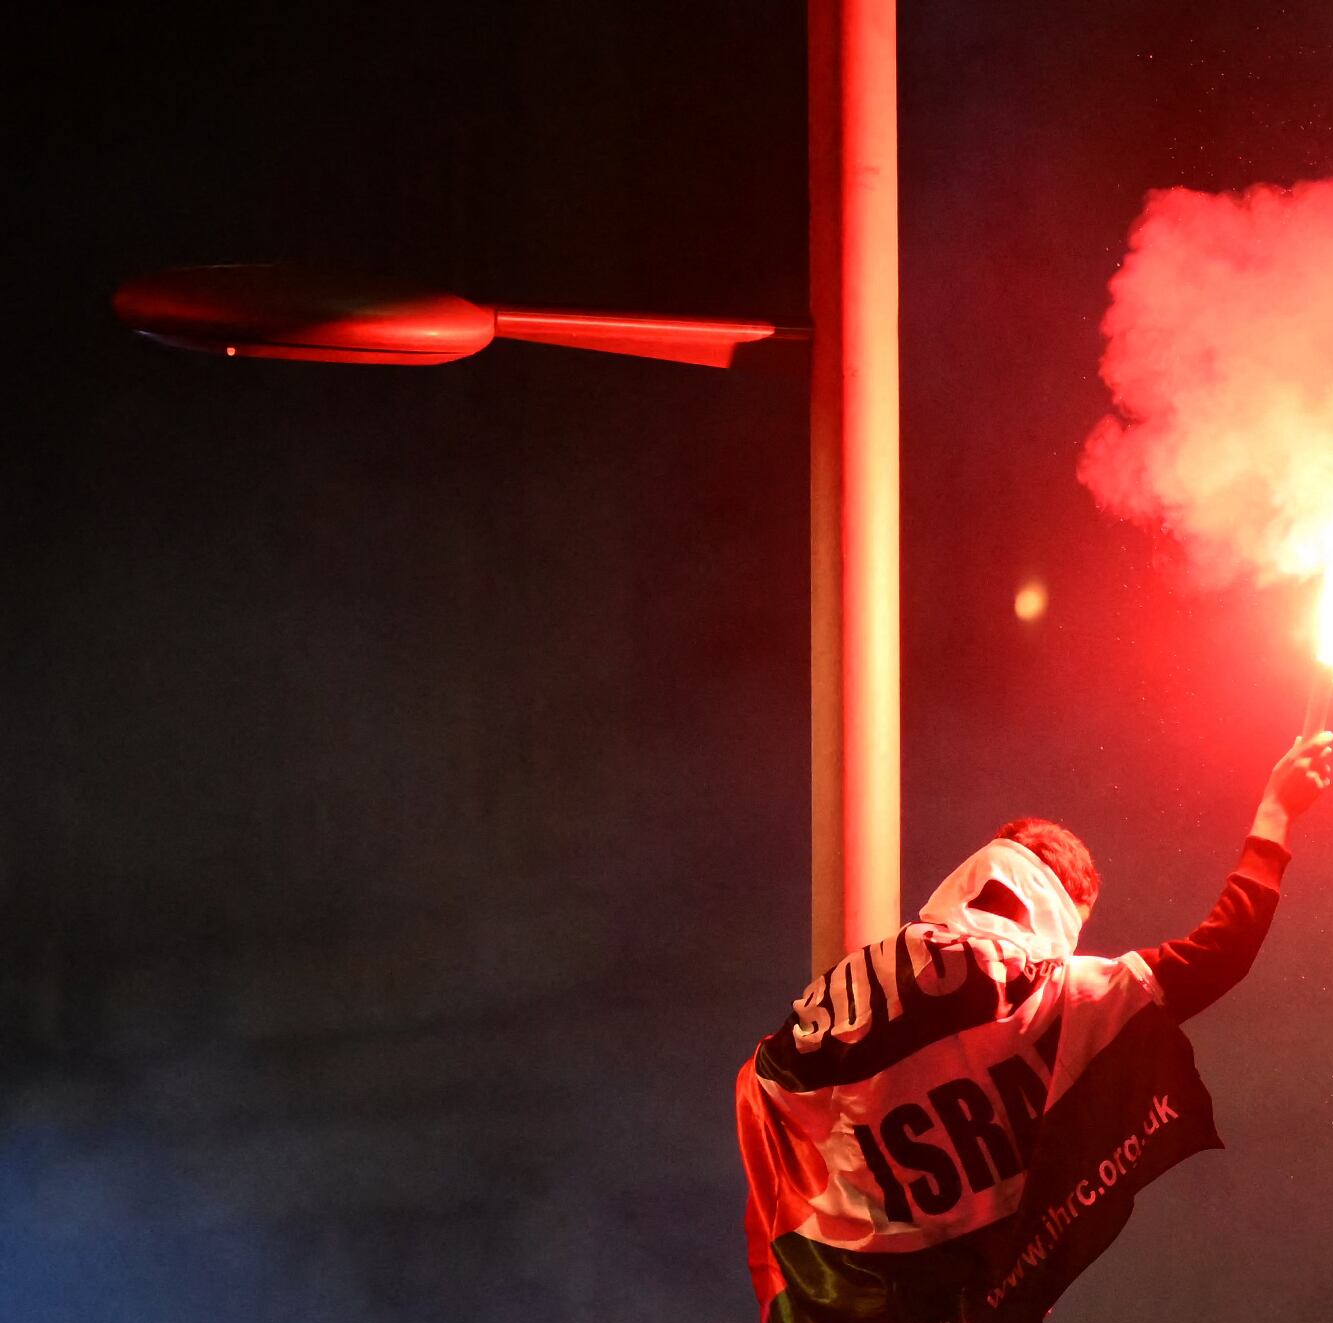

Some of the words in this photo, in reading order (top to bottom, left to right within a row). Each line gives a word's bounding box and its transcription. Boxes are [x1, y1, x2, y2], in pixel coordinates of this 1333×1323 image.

[793, 921, 968, 1053] BOYC
[853, 1015, 1062, 1223] ISRA
[987, 1094, 1179, 1308] www.ihrc.org.uk
